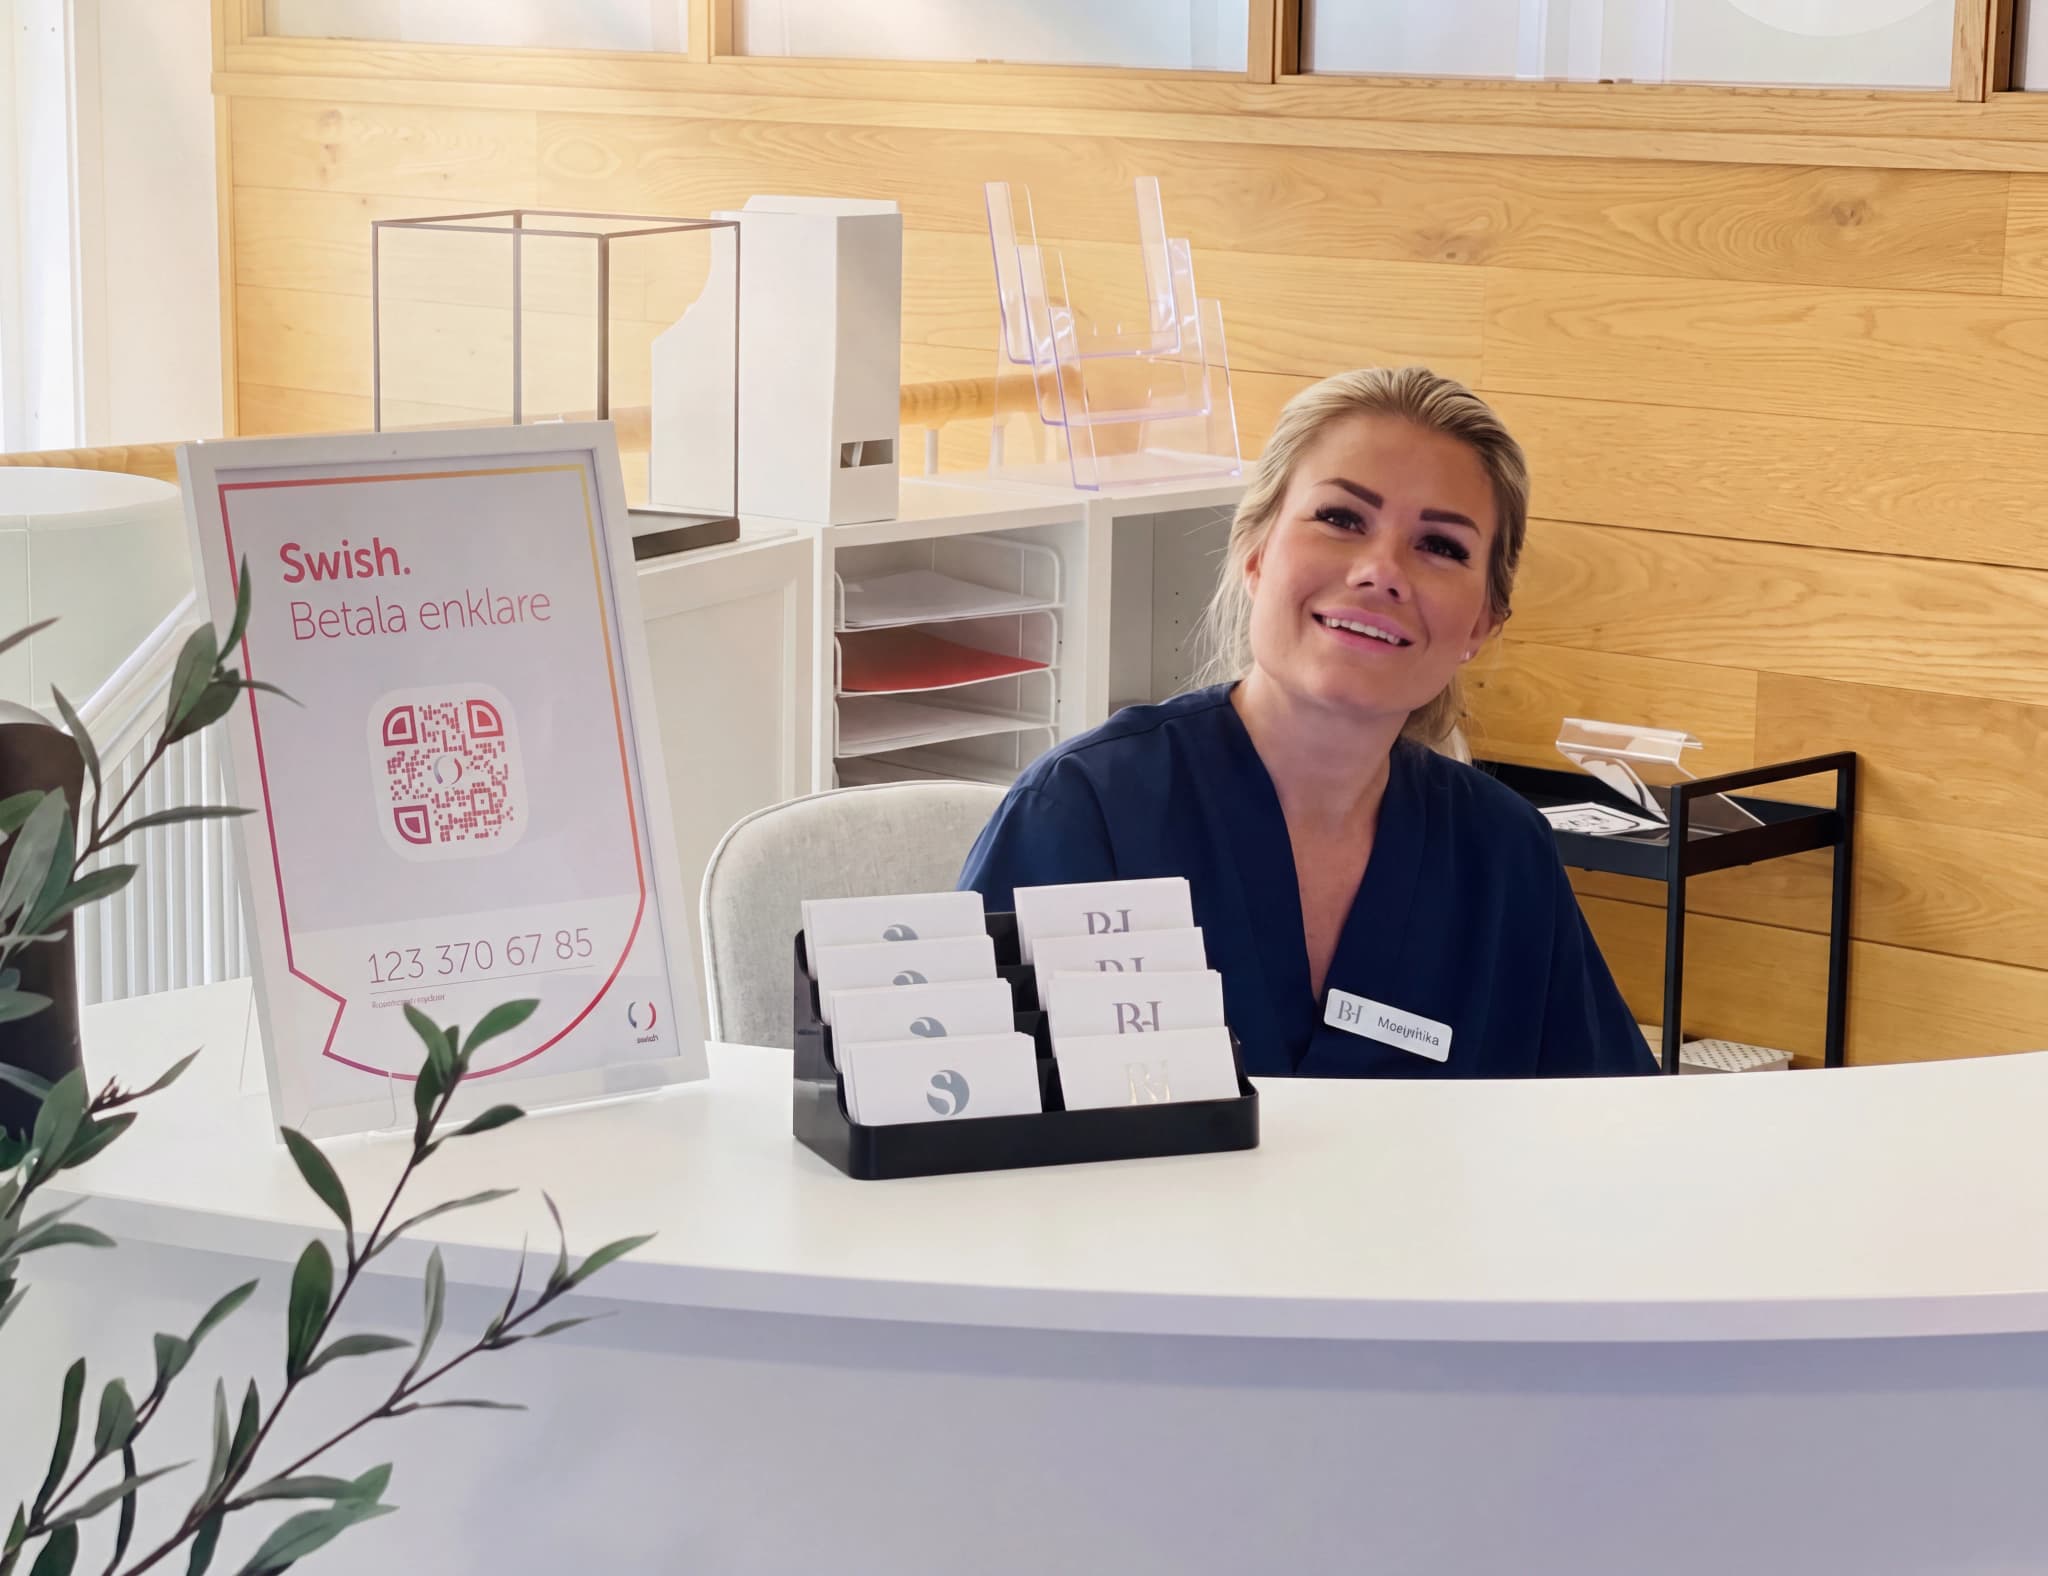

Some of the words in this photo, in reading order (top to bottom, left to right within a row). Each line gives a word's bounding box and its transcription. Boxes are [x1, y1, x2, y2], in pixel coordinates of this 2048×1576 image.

[279, 536, 411, 584] Swish.
[290, 595, 407, 640] Betala
[419, 587, 551, 631] enklare
[368, 948, 425, 984] 123
[435, 940, 494, 975] 370
[506, 933, 542, 966] 67
[555, 927, 593, 960] 85
